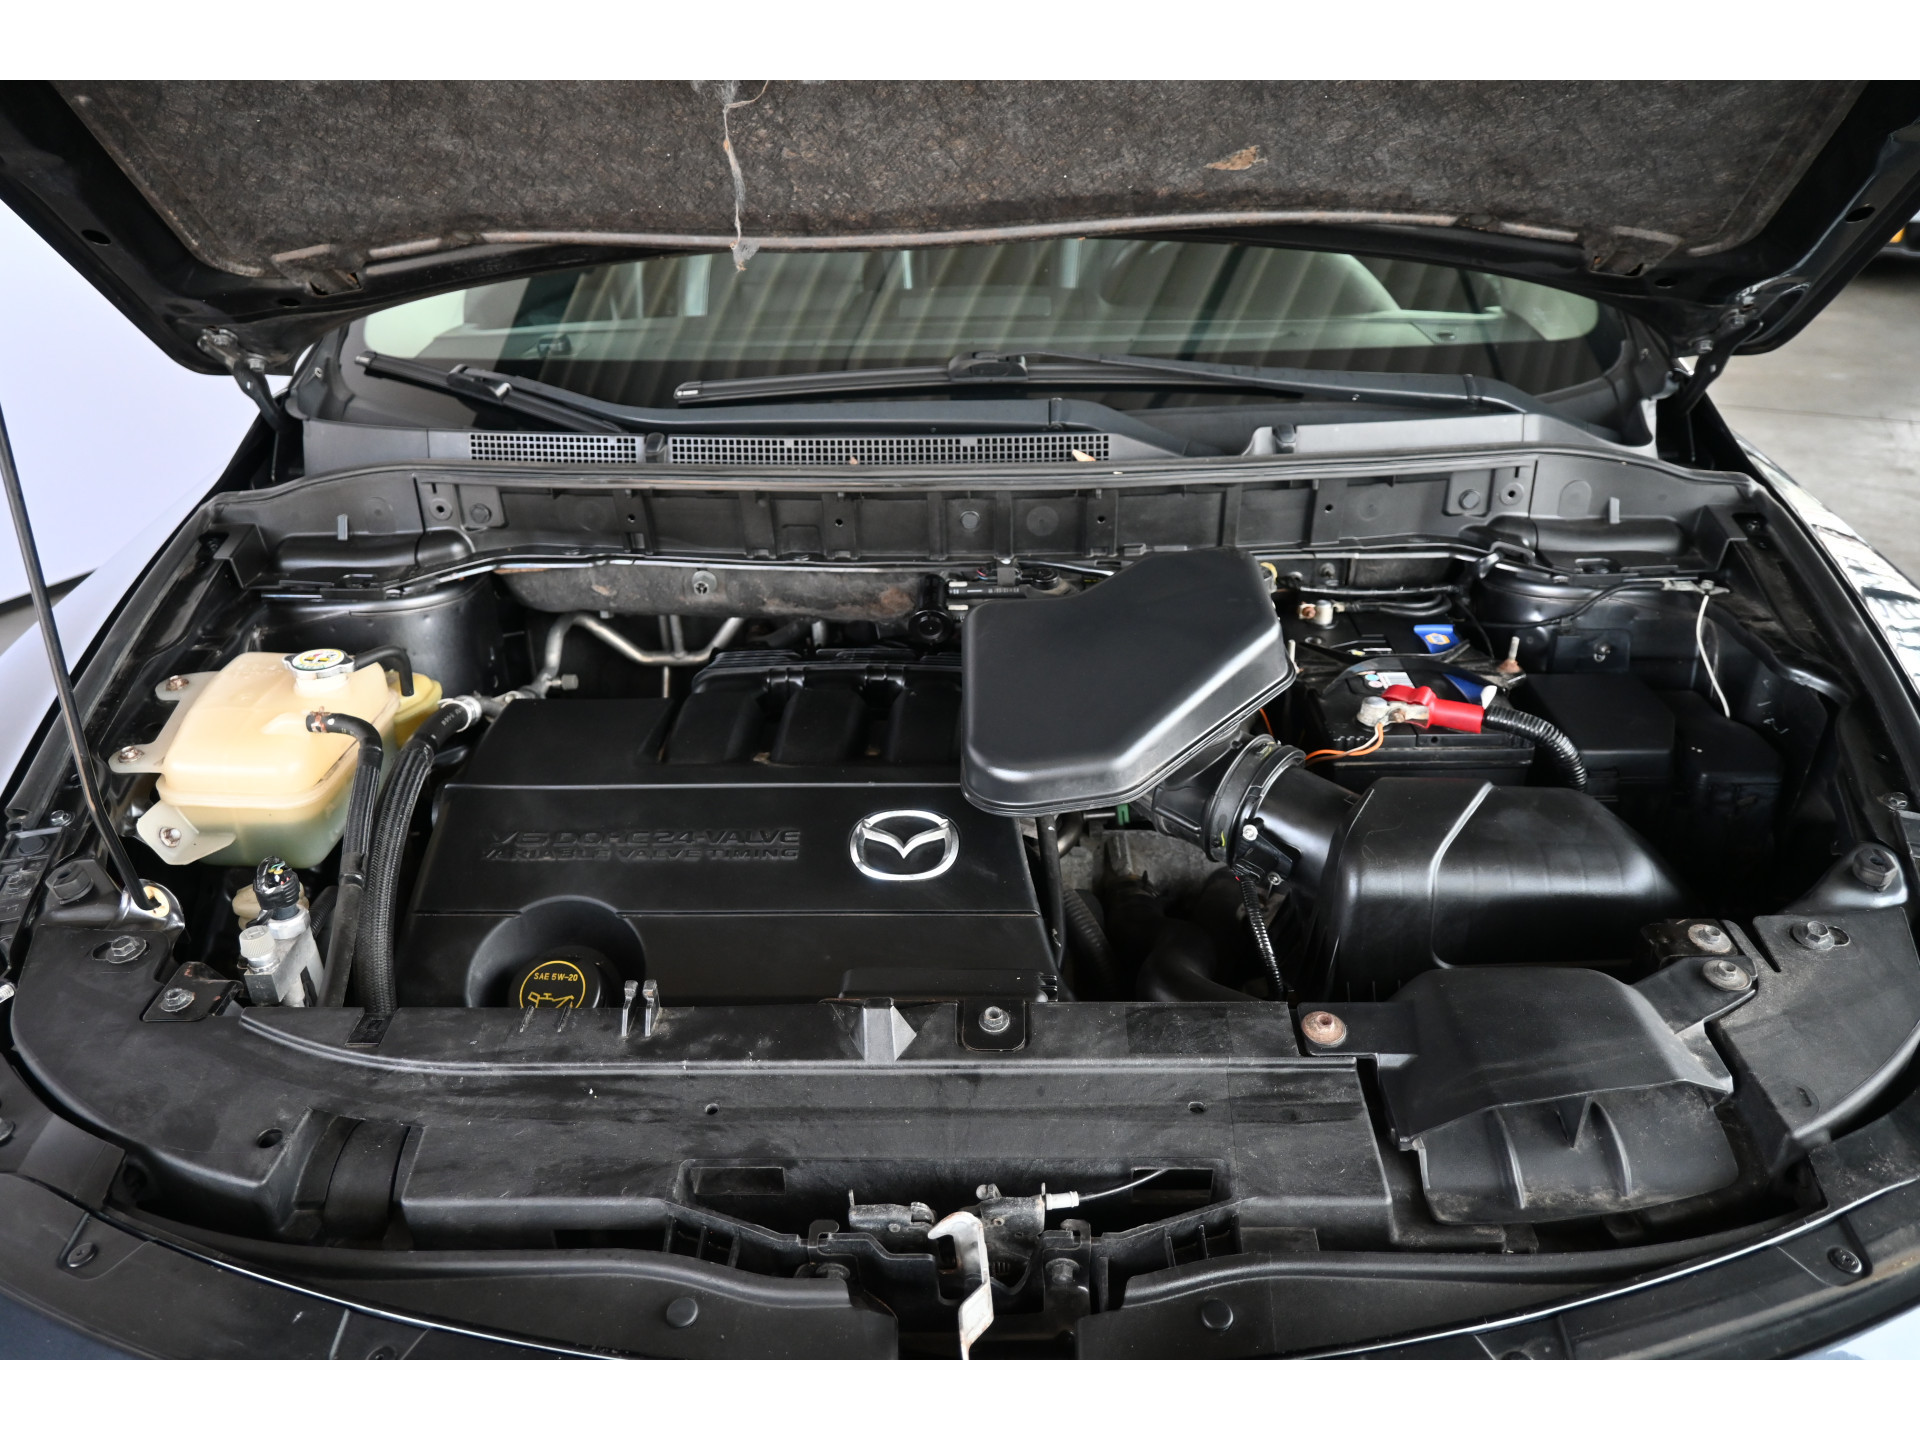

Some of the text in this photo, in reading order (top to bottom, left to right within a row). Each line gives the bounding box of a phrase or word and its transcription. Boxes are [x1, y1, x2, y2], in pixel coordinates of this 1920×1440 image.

[652, 830, 801, 846] 24-VALVE
[615, 849, 702, 862] VALVE
[706, 849, 799, 861] TIMING
[533, 972, 579, 982] SAE 5W-20
